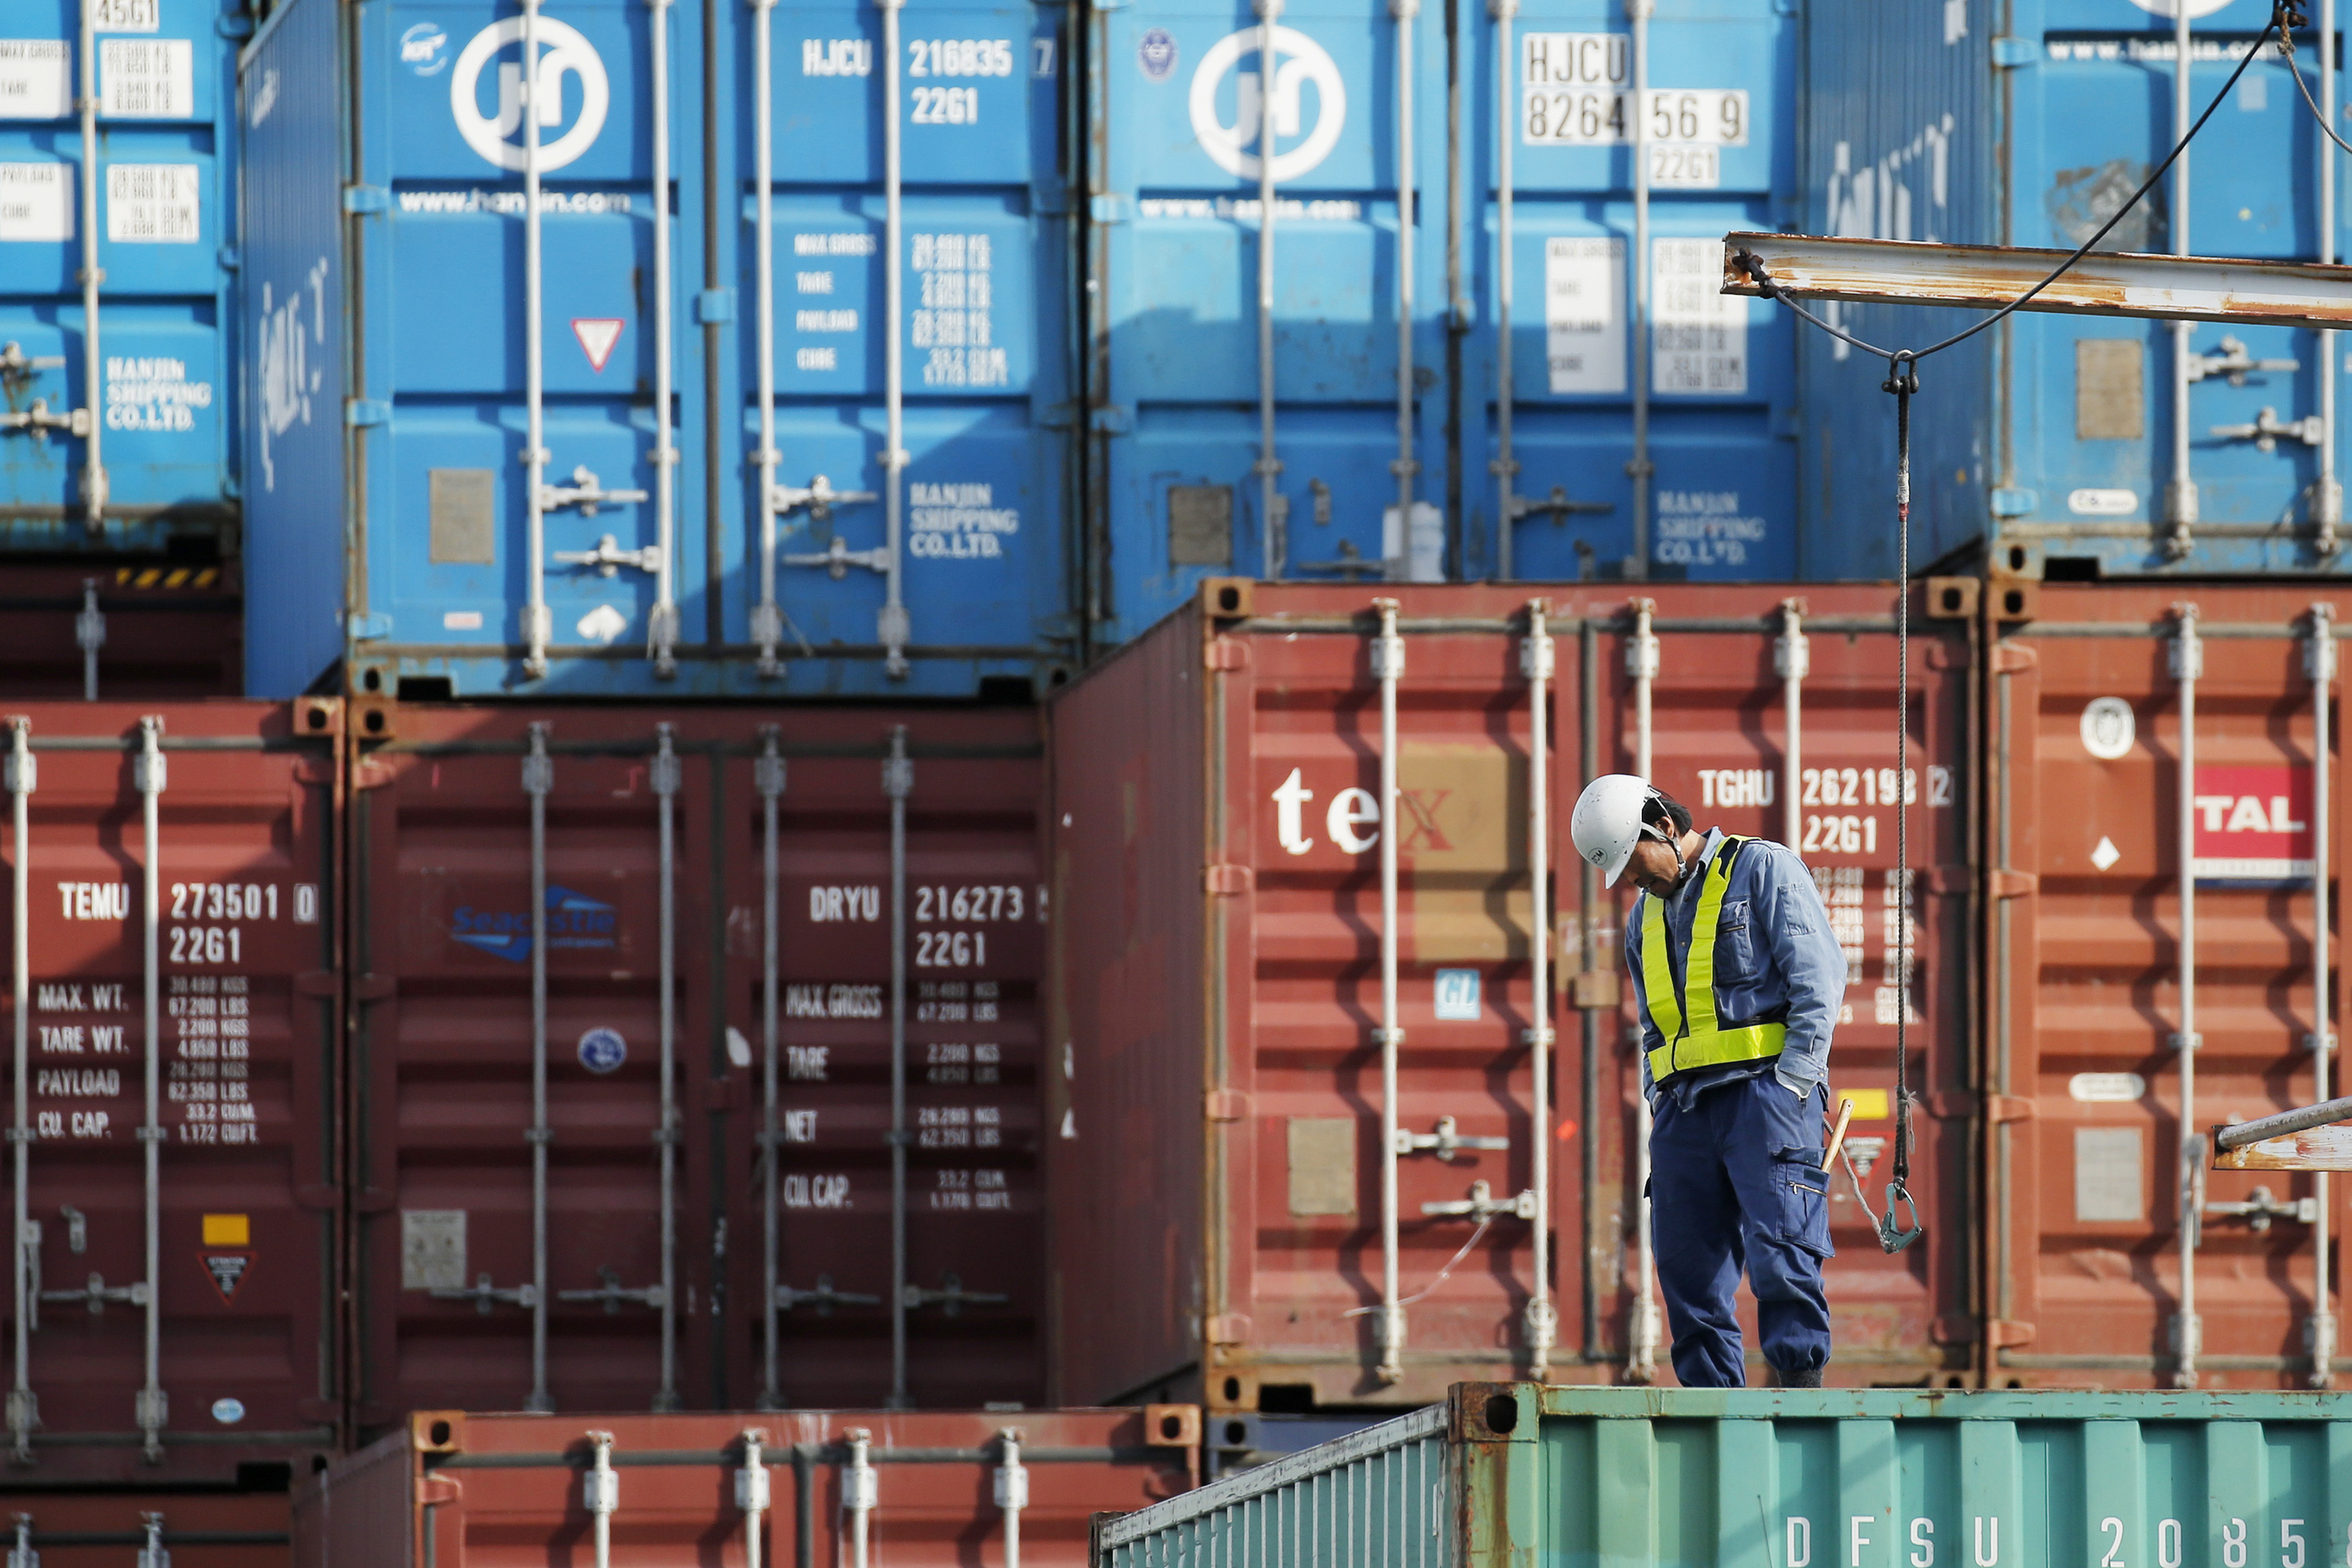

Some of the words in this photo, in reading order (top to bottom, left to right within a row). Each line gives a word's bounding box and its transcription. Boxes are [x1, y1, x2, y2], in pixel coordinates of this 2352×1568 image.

[802, 39, 873, 76] HJCU
[909, 39, 1013, 78] 216835
[1527, 38, 1626, 83] HJCU
[911, 87, 979, 125] 22G1
[1653, 151, 1716, 180] 22G1
[400, 187, 632, 213] www.hanin.com
[1140, 195, 1361, 220] www.hanin.com
[106, 356, 186, 381] HANJIN
[106, 382, 212, 408] SHIPPING
[909, 483, 993, 506] HANJIN
[1657, 492, 1739, 514] HANJIN
[909, 509, 1020, 534] SHIPPING
[1657, 515, 1766, 541] SHIPPING
[1698, 770, 1773, 807] TGHU
[1802, 768, 1917, 805] 262198
[2193, 795, 2307, 833] TAL
[1802, 815, 1877, 852] 22G1
[58, 882, 129, 920] TEMU
[171, 883, 278, 920] 273501
[298, 885, 315, 921] 0
[810, 886, 880, 921] DRYU
[915, 886, 1024, 921] 216273
[452, 907, 615, 932] Seacstle
[169, 927, 240, 962] 22G1
[915, 931, 986, 967] 22G1
[38, 984, 88, 1010] MAX.
[92, 984, 129, 1011] WT.
[39, 1026, 83, 1052] TARE
[92, 1026, 129, 1053] WT.
[786, 1047, 830, 1081] TARE
[38, 1069, 120, 1096] PAYLOAD
[785, 1109, 818, 1144] NET
[1786, 1515, 1999, 1568] DFSU
[2100, 1515, 2352, 1568] 2085
